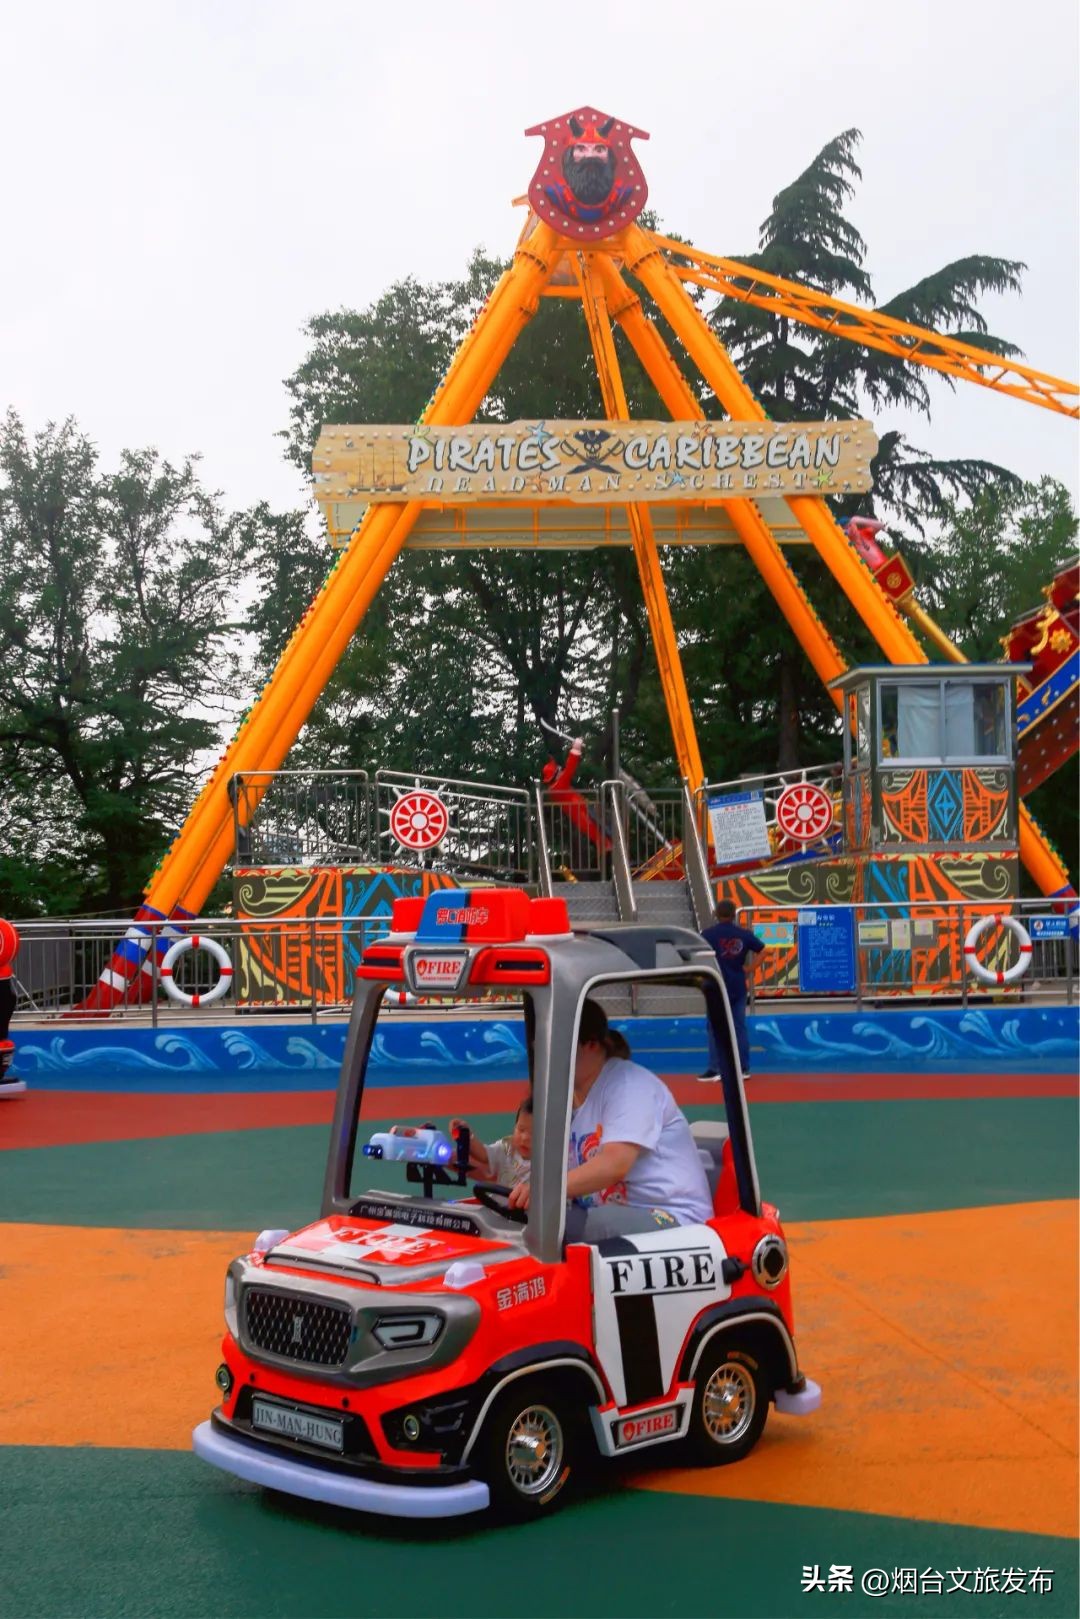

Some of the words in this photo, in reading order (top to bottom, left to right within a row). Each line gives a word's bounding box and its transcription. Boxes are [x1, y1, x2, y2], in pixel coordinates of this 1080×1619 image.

[408, 437, 561, 473] PIRATES
[624, 434, 840, 470] CARIBBEAN
[426, 475, 526, 493] DEAD
[690, 472, 808, 490] CHEST
[427, 961, 461, 974] FIRE
[606, 1253, 716, 1294] FIRE
[496, 1276, 546, 1311] 金满鸿
[255, 1407, 342, 1444] JIN-MAN-HUNG
[636, 1413, 673, 1435] FIRE
